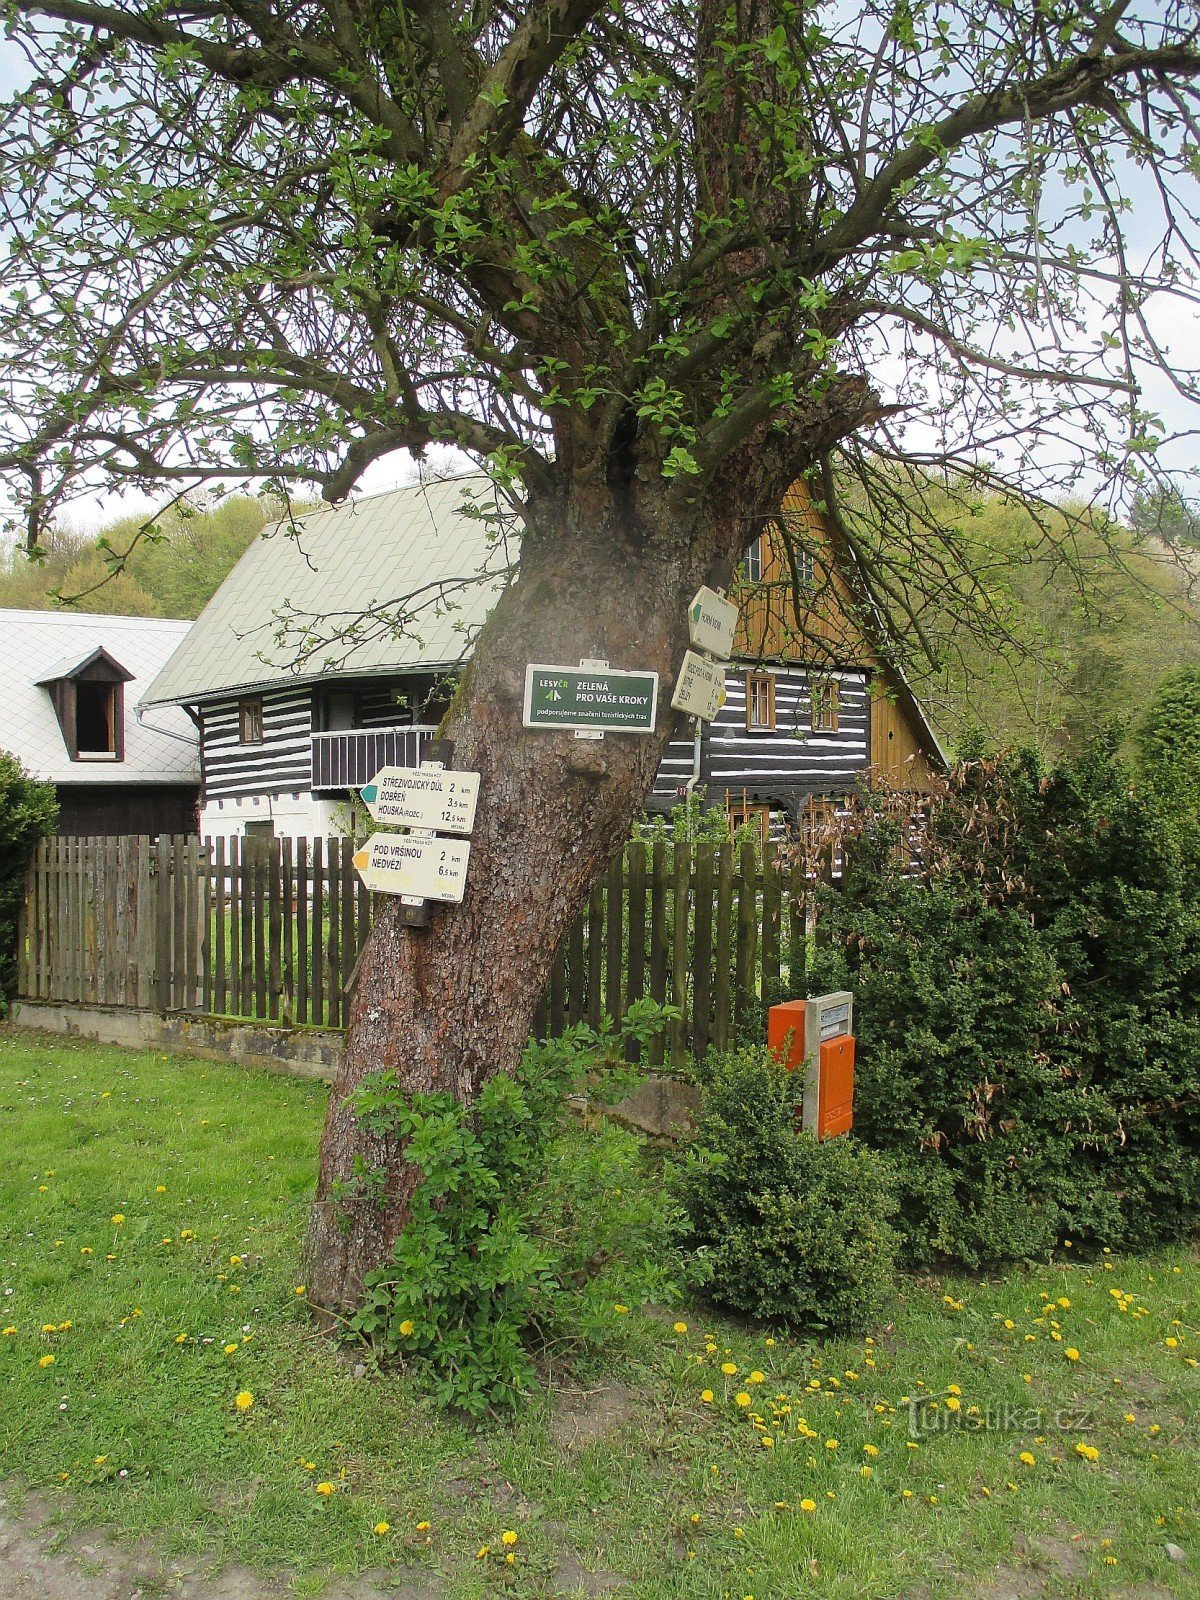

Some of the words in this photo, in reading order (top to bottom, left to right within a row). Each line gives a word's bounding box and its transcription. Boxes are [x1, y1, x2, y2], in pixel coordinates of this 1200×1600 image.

[576, 681, 609, 692] ZELENÁ
[575, 693, 594, 703] PRO
[595, 693, 617, 704] VAŠE
[618, 695, 649, 706] KROKY
[536, 708, 577, 718] podporujeme
[578, 710, 601, 719] značení
[601, 711, 635, 721] turistických
[382, 775, 430, 790] STŘEZIVOJICKÝ
[430, 779, 443, 792] DŮL
[449, 783, 456, 793] 2
[460, 787, 471, 795] km
[380, 789, 407, 802] DOBŘEŇ
[447, 797, 458, 808] 3,5
[458, 800, 469, 809] km
[440, 811, 456, 822] 12,5
[456, 815, 466, 823] km
[373, 844, 389, 855] POD
[390, 844, 422, 859] VRŠINOU
[440, 851, 446, 861] 2
[451, 855, 461, 863] km
[438, 865, 449, 876] 6,5
[449, 869, 459, 877] km
